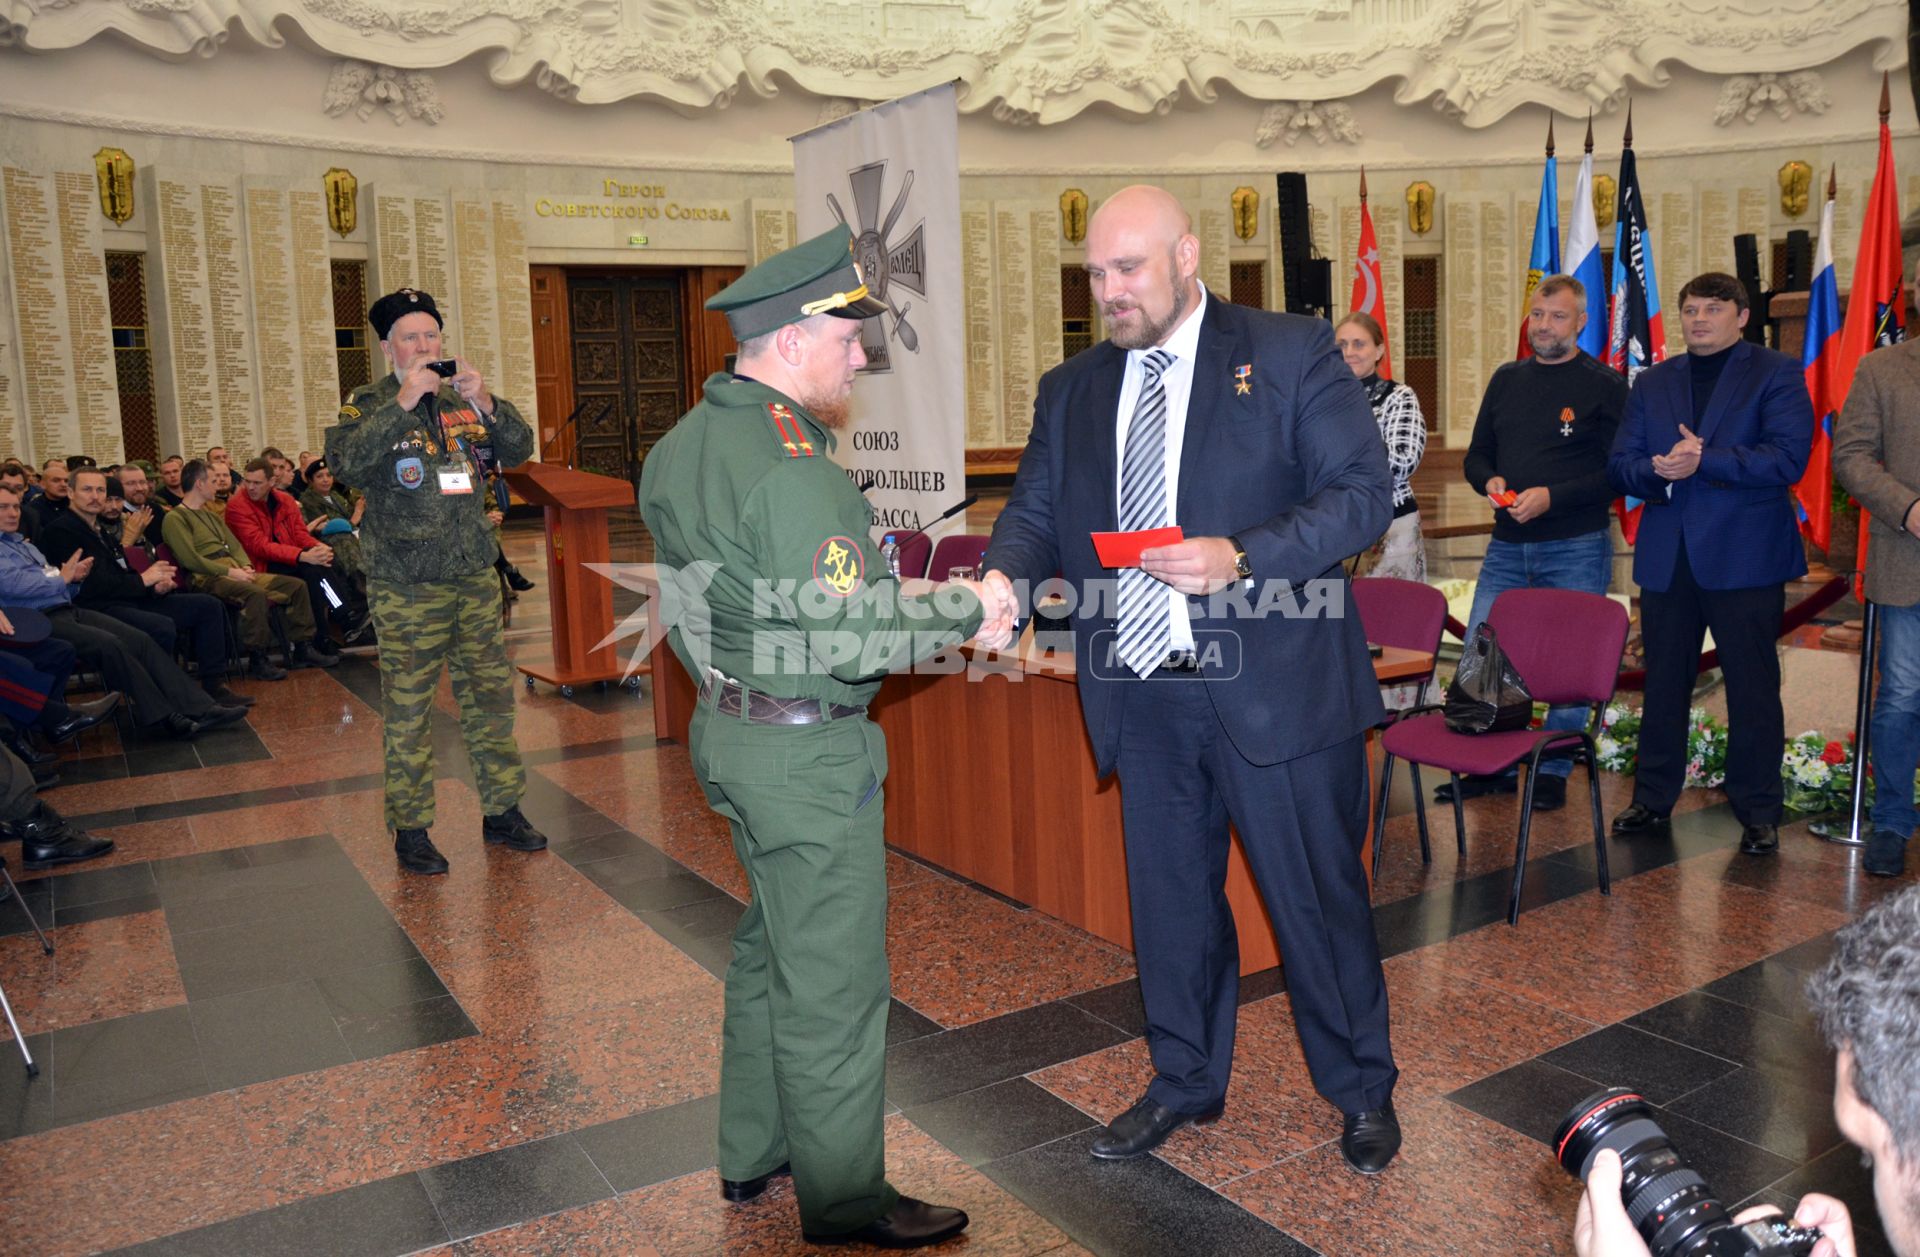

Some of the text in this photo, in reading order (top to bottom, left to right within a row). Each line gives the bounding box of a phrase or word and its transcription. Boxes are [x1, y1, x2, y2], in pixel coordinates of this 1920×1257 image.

[853, 431, 899, 451] СОЮЗ
[846, 468, 945, 494] РОВОЛЬЦЕВ
[871, 507, 921, 530] БАССА
